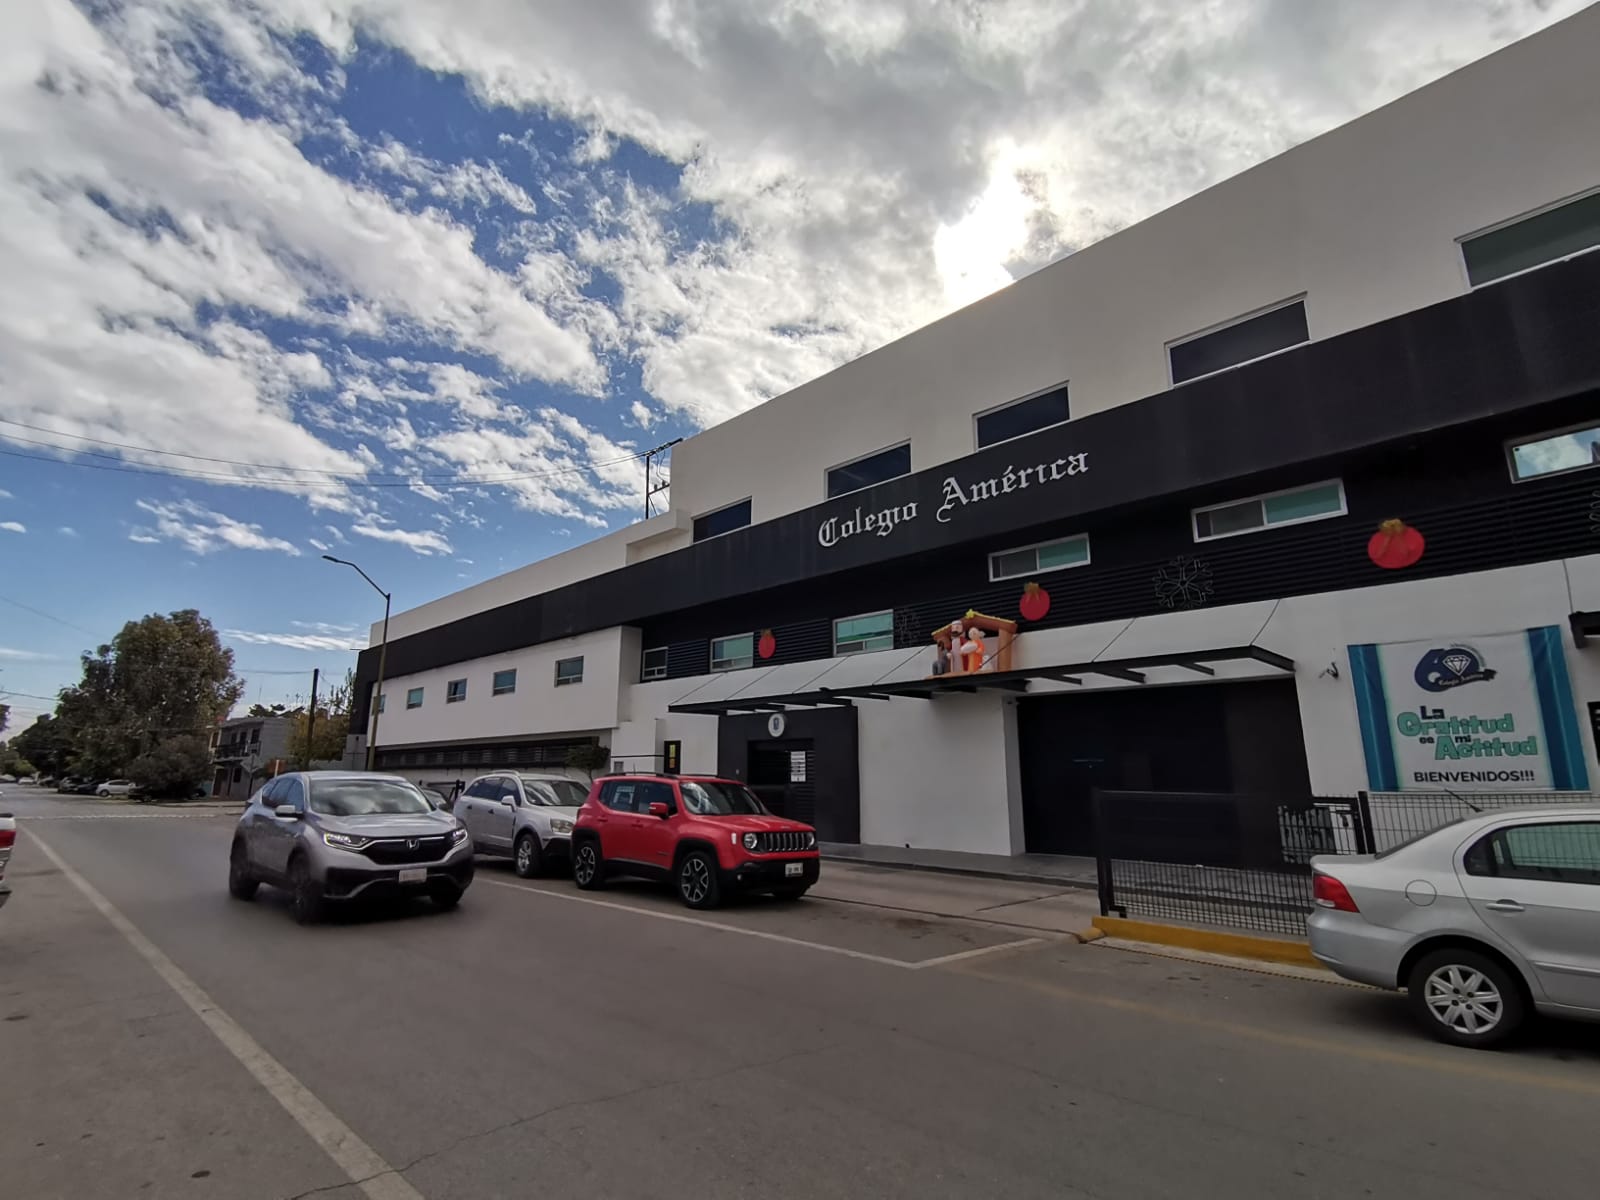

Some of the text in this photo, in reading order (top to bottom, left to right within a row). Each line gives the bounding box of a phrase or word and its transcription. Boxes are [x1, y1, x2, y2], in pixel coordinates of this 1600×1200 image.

[818, 452, 1089, 547] Colegio América
[1420, 705, 1445, 719] La
[1397, 711, 1514, 736] Gratitud
[1435, 735, 1538, 760] Actitud
[1455, 735, 1471, 743] mi
[1414, 770, 1535, 782] BIENVENIDOS!!!
